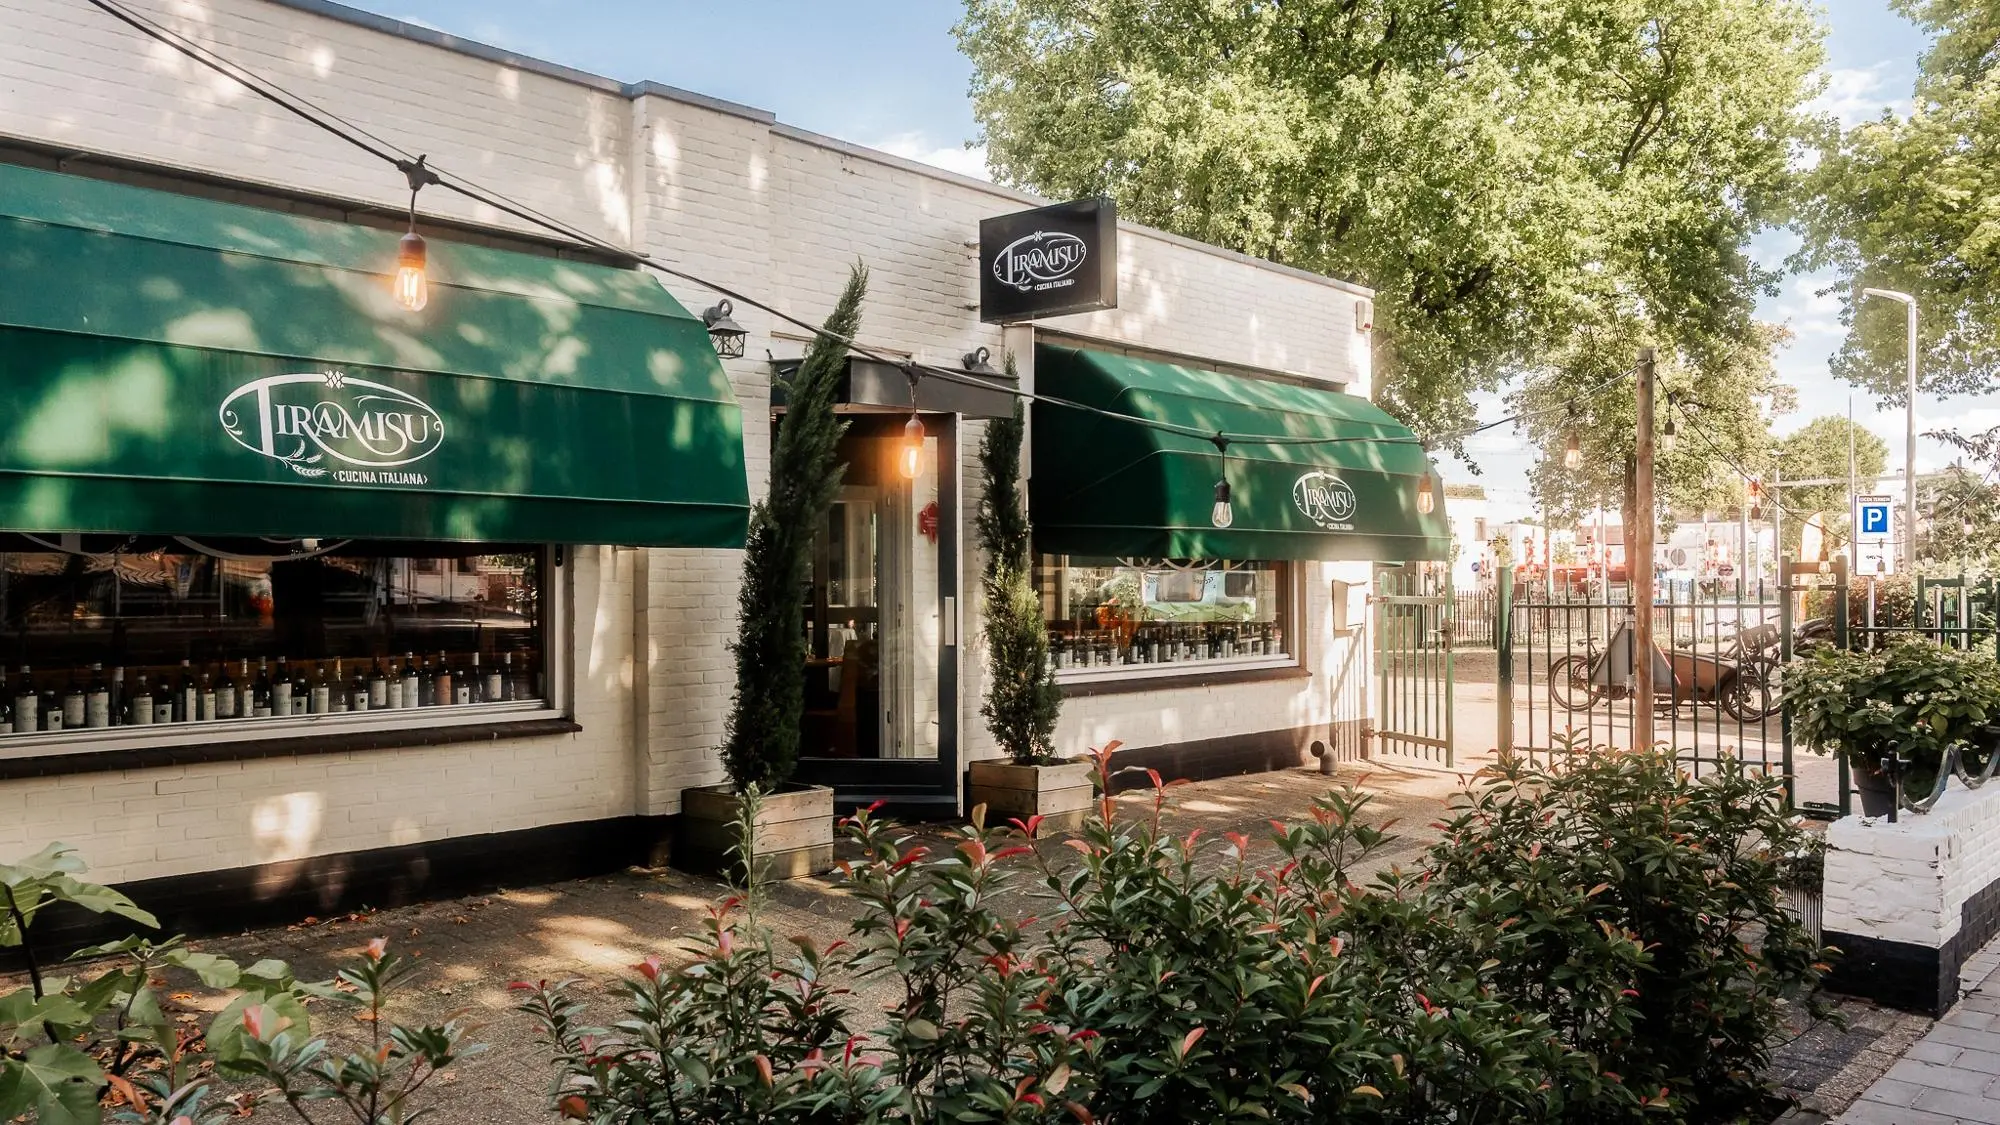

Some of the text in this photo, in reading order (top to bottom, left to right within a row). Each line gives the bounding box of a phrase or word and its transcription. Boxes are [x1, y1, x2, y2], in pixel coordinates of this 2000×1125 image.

[997, 231, 1081, 284] TIRAMISU
[234, 373, 436, 462] TIRAMISU
[1295, 472, 1353, 518] TIRAMISU
[1868, 509, 1882, 530] P
